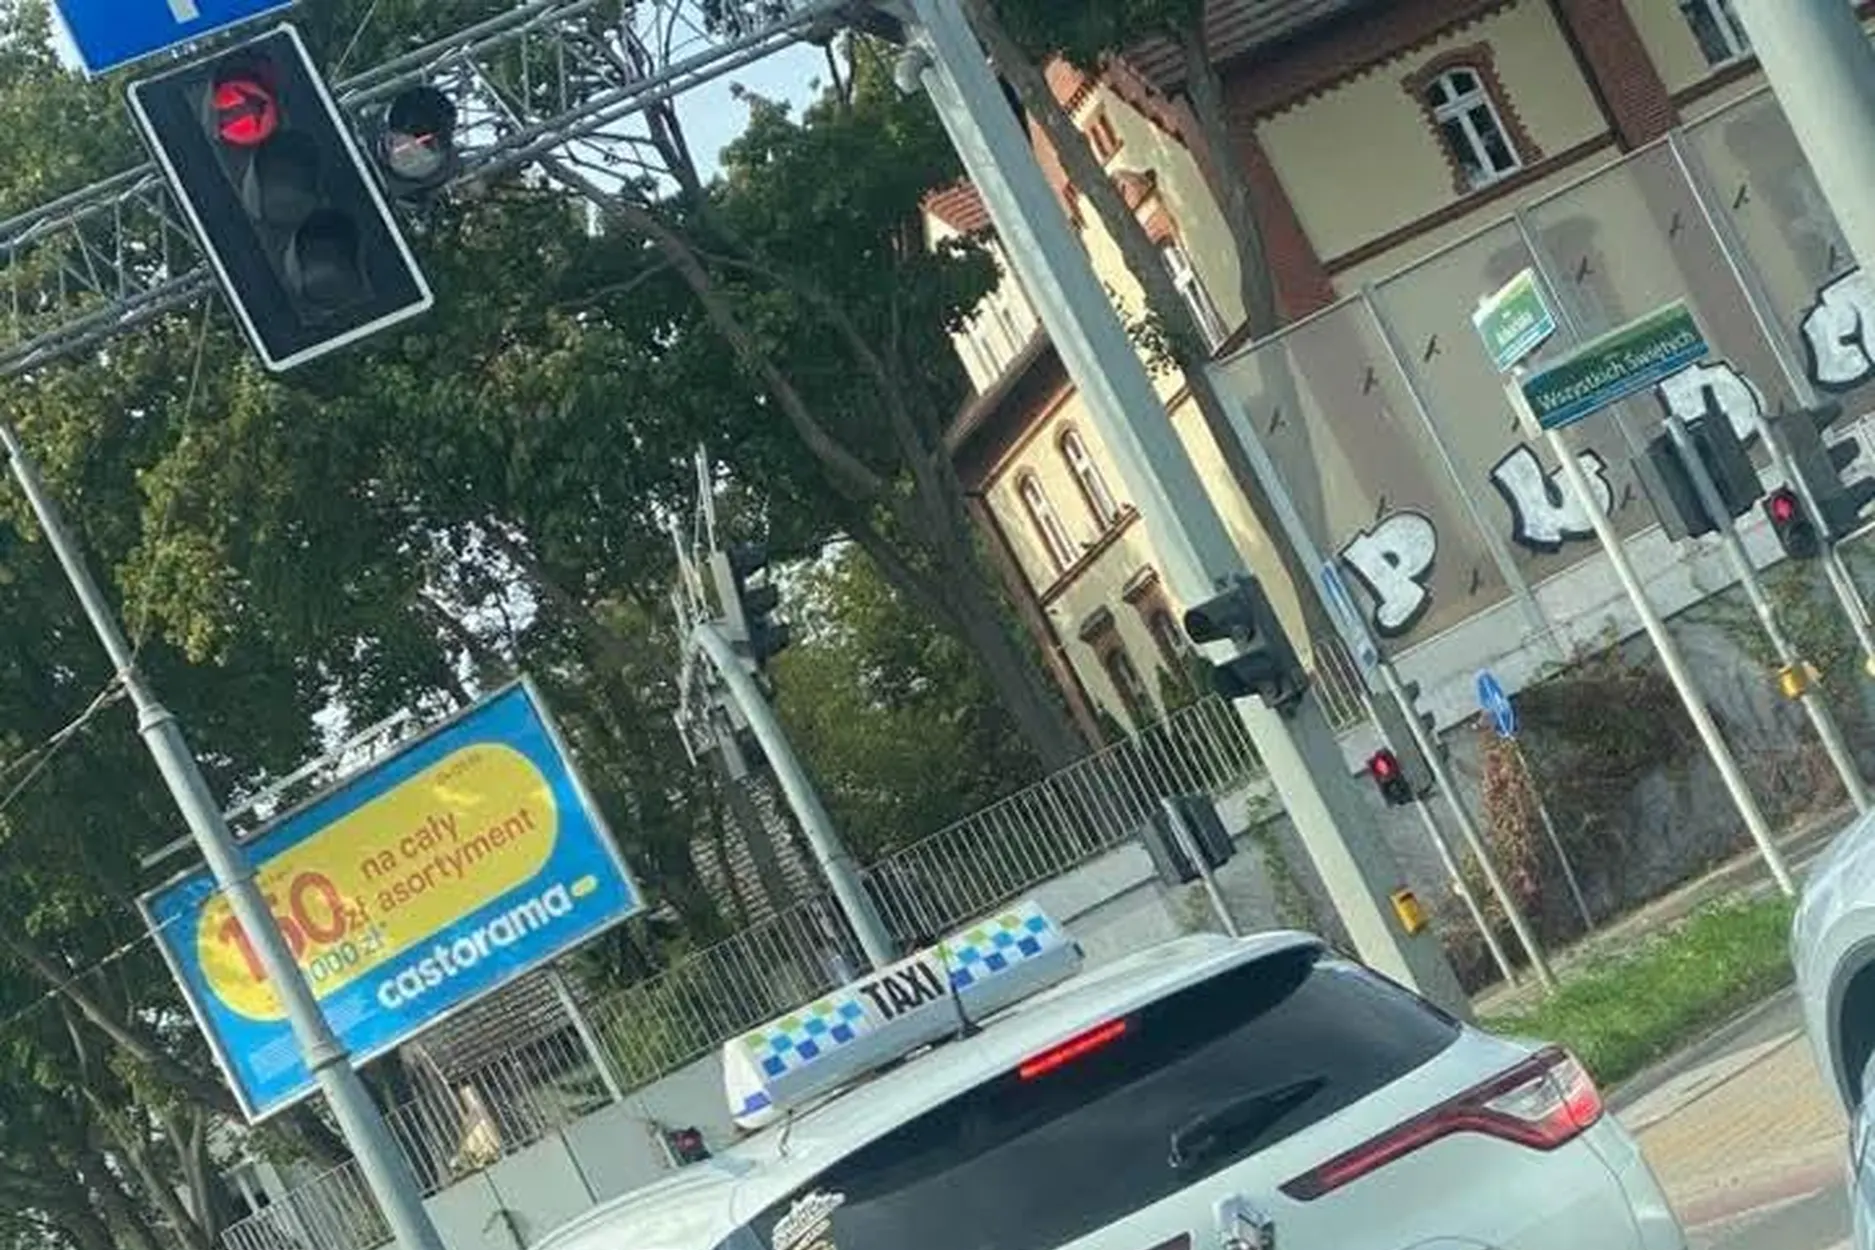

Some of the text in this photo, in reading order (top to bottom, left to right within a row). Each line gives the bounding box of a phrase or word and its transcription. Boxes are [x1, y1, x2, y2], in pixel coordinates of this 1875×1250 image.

[360, 812, 459, 881] na cały
[376, 807, 537, 912] asortyment
[376, 881, 575, 1010] castorama
[859, 961, 947, 1021] TAXI
